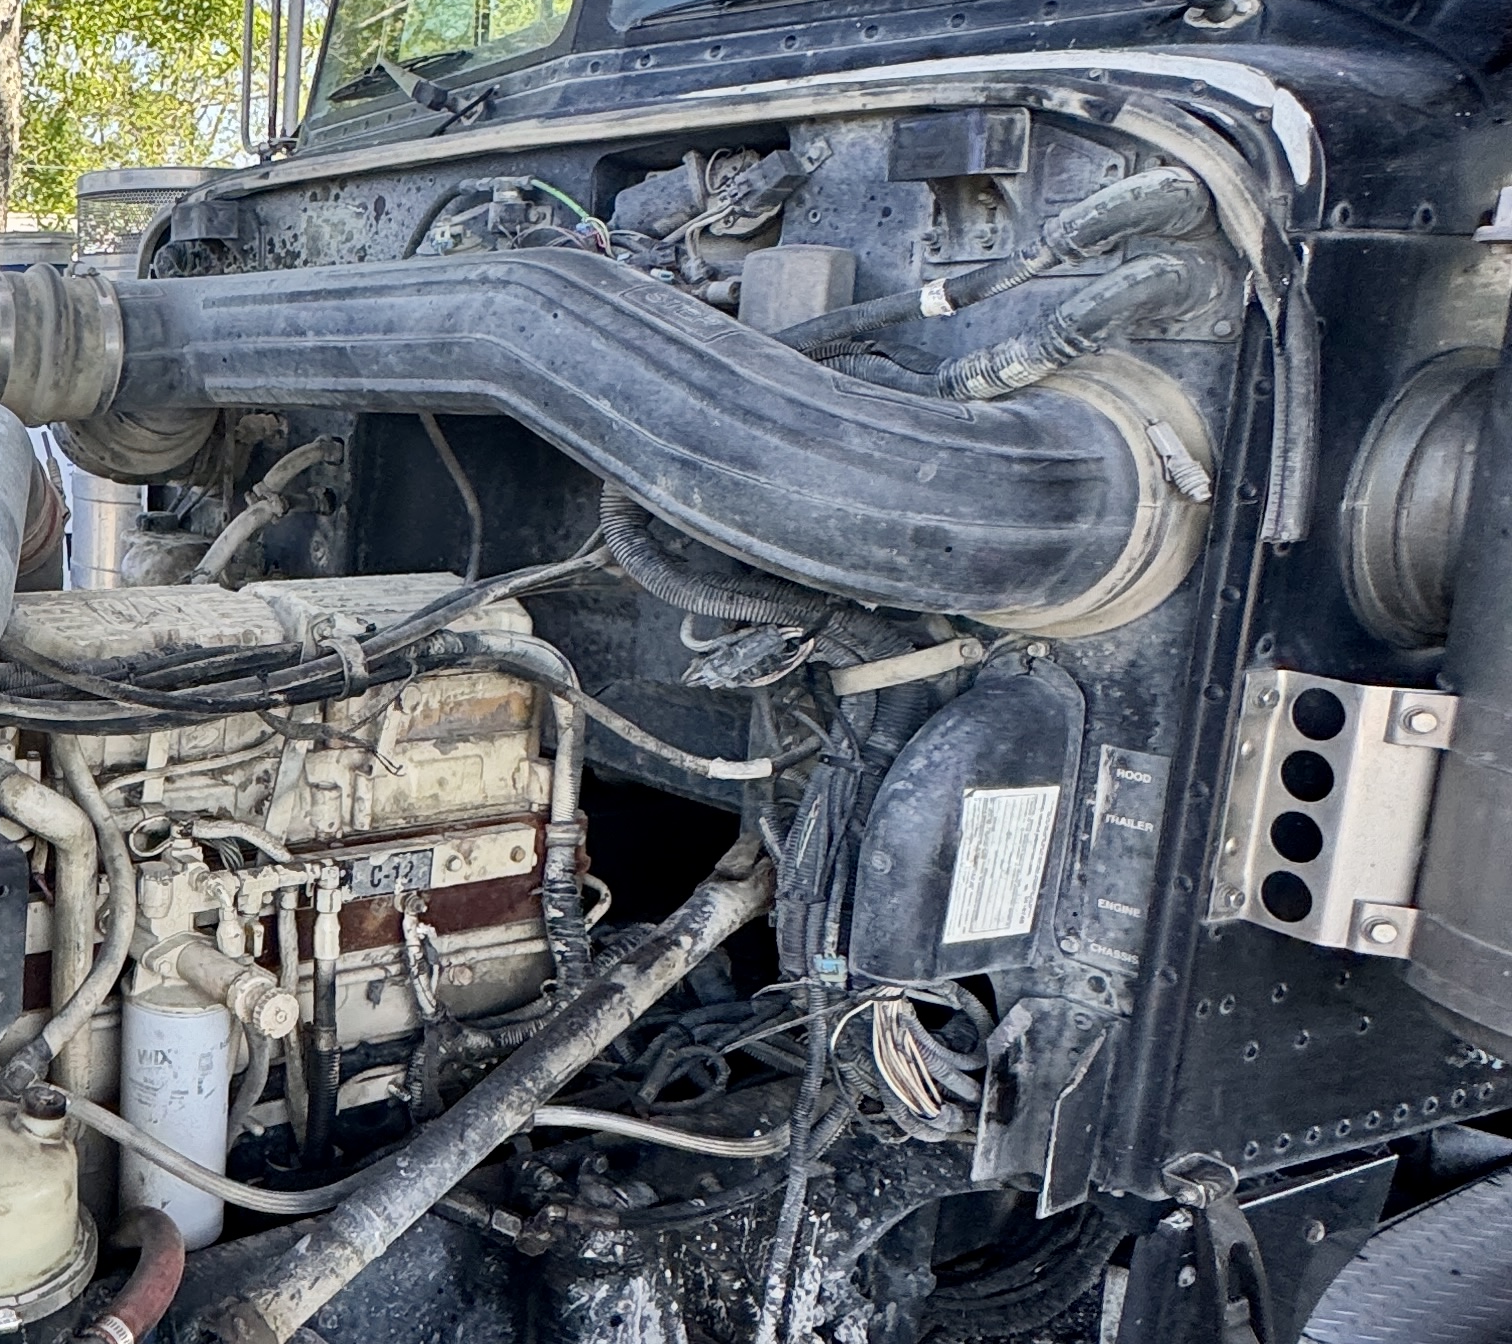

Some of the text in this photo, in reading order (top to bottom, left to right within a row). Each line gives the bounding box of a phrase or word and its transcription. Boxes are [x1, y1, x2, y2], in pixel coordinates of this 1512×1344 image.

[1116, 768, 1152, 784] HOOD
[1106, 814, 1154, 832] TRAILER
[370, 860, 414, 888] C-12
[1097, 898, 1141, 918] ENGINE
[1089, 942, 1139, 964] CHASSIS
